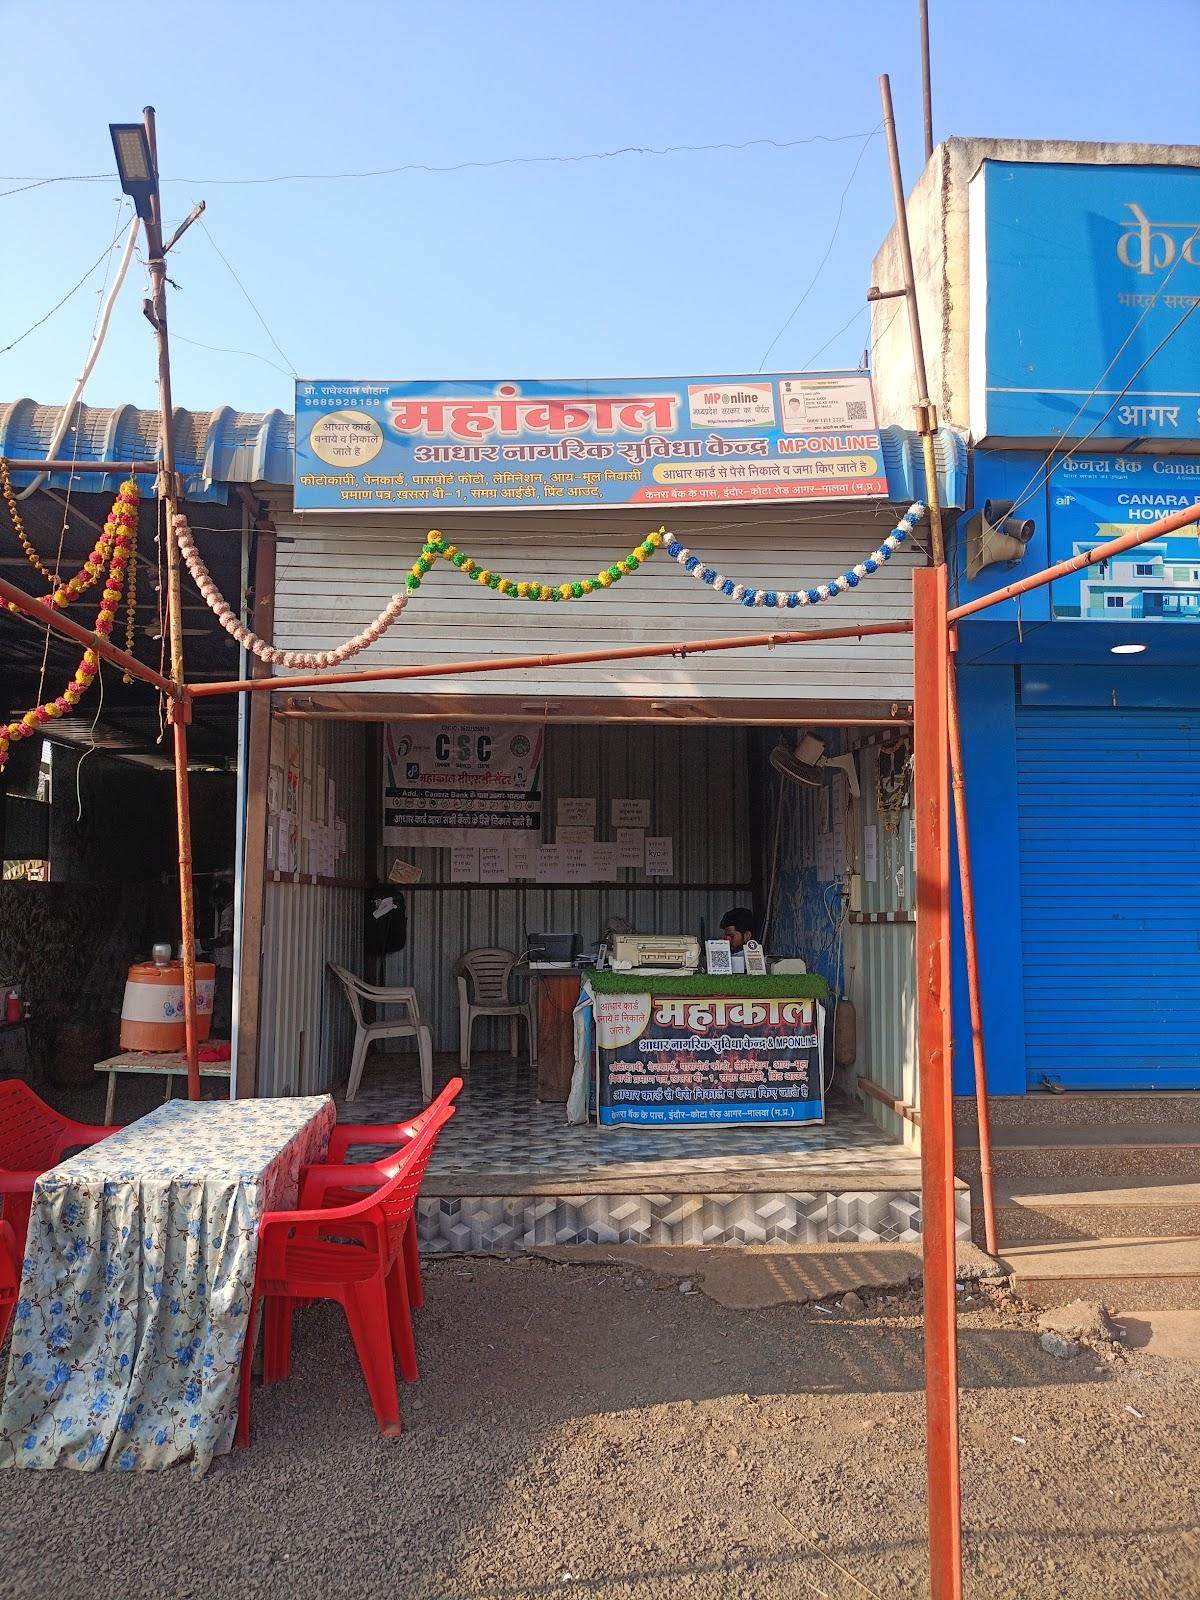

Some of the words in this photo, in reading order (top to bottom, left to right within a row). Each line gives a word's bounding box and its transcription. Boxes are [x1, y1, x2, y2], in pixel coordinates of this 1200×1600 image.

[304, 384, 319, 396] प्रो.
[321, 384, 360, 395] राधेश्याम
[305, 398, 380, 406] 9685928159
[391, 385, 676, 439] महांकाल
[721, 407, 741, 415] सरकार
[743, 406, 752, 414] का
[1118, 405, 1180, 428] आगर
[323, 423, 350, 432] आधार
[351, 420, 372, 432] कार्ड
[340, 435, 347, 444] व
[349, 432, 379, 444] निकाले
[779, 436, 879, 453] MPONLINE
[333, 445, 352, 456] जाते
[415, 444, 499, 462] आधार
[502, 438, 613, 461] नागरिक
[617, 435, 702, 465] सुविधा
[706, 433, 769, 456] केन्द्र
[663, 469, 692, 480] आधार
[695, 465, 715, 479] कार्ड
[718, 466, 727, 478] से
[730, 465, 746, 478] पैसे
[748, 463, 780, 477] निकाले
[783, 465, 790, 475] व
[792, 464, 812, 475] जमा
[815, 460, 835, 475] किए
[837, 460, 858, 473] जाते
[860, 460, 868, 473] है
[1063, 457, 1110, 472] केनरा
[1115, 457, 1142, 472] बैंक
[300, 473, 359, 487] फोटोकापी,
[363, 472, 408, 487] पेनकार्ड,
[412, 472, 454, 486] पासपोर्ट
[457, 471, 489, 486] फोटो,
[493, 471, 547, 486] लेमिनेशन,
[604, 469, 642, 481] निवासी
[341, 489, 373, 500] प्रमाण
[471, 488, 498, 499] समग्र
[500, 485, 540, 499] आईडी,
[544, 485, 564, 498] प्रिंट
[567, 486, 604, 498] आउट,
[645, 488, 669, 499] केनरा
[688, 488, 697, 498] के
[699, 487, 720, 498] पास,
[852, 482, 881, 493] (म.प्र.)
[1117, 494, 1190, 505] CANARA
[451, 791, 468, 799] Bank
[600, 1002, 622, 1012] आधार
[623, 1000, 640, 1011] कार्ड
[621, 1013, 646, 1023] निकाले
[609, 1026, 626, 1035] जाते
[639, 1037, 670, 1052] आधार
[670, 1036, 710, 1051] नागरिक
[710, 1034, 743, 1054] सुविधा
[743, 1034, 767, 1050] केन्द्र
[767, 1037, 774, 1049] &
[774, 1035, 817, 1048] MPONLINE
[613, 1089, 640, 1101] आधार
[641, 1087, 663, 1101] कार्ड
[664, 1087, 674, 1101] से
[675, 1086, 693, 1100] पैसे
[693, 1086, 726, 1099] निकाले
[727, 1087, 735, 1099] व
[736, 1087, 757, 1098] जमा
[758, 1084, 778, 1100] किए
[778, 1084, 800, 1098] जाते
[641, 1110, 648, 1120] के
[649, 1110, 667, 1121] पास,
[771, 1106, 795, 1117] (म.प्र.)
